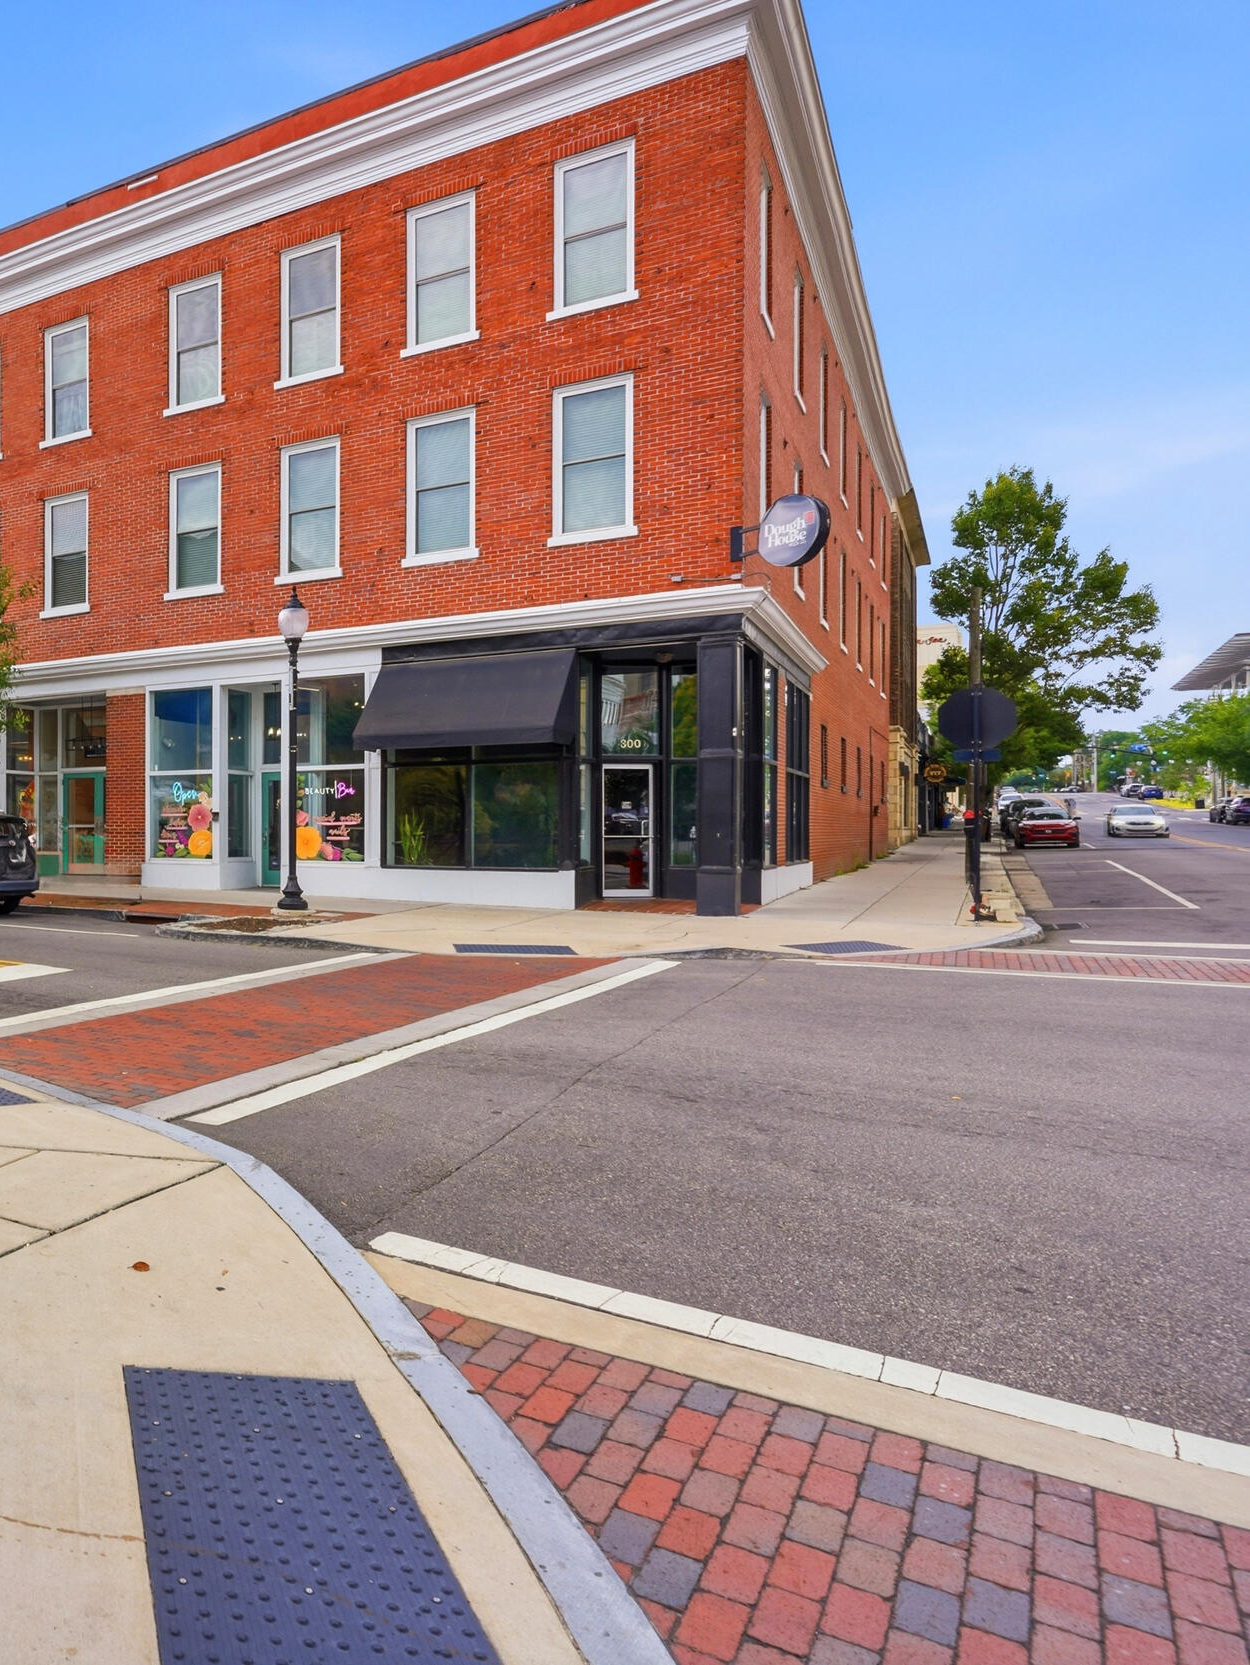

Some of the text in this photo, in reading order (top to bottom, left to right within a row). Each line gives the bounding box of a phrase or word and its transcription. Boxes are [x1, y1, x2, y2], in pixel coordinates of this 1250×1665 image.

[764, 517, 807, 537] Dough
[767, 530, 807, 548] House
[620, 739, 642, 749] 300
[172, 781, 199, 806] Open
[304, 787, 335, 795] BEAUTY
